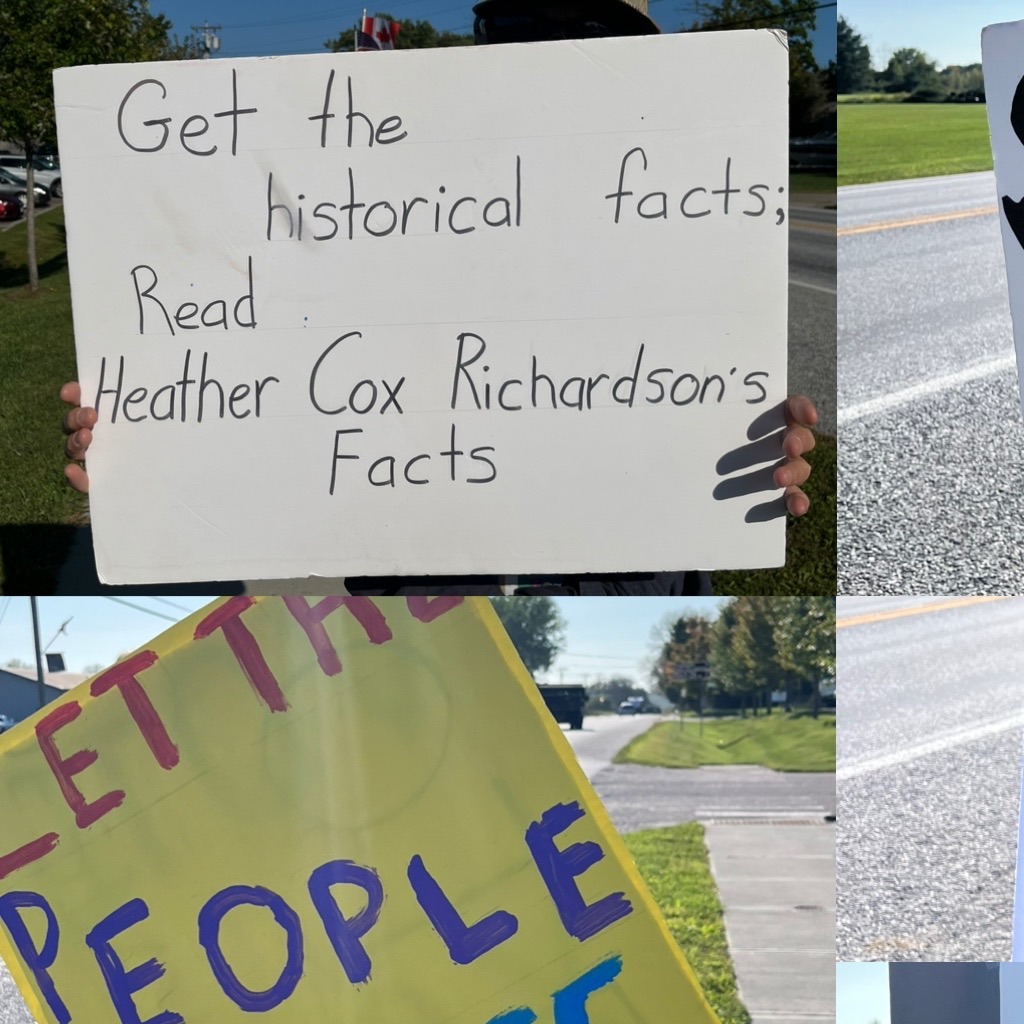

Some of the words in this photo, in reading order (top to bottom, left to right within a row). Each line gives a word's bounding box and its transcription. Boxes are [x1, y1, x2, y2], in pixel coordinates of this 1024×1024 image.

[117, 70, 258, 157] Get
[307, 68, 408, 148] the
[266, 155, 522, 242] historical
[604, 147, 785, 226] facts;
[130, 255, 258, 337] Read
[93, 348, 280, 424] Heather
[309, 331, 406, 416] Cox
[450, 332, 770, 413] Richardson's
[329, 423, 497, 496] Facts
